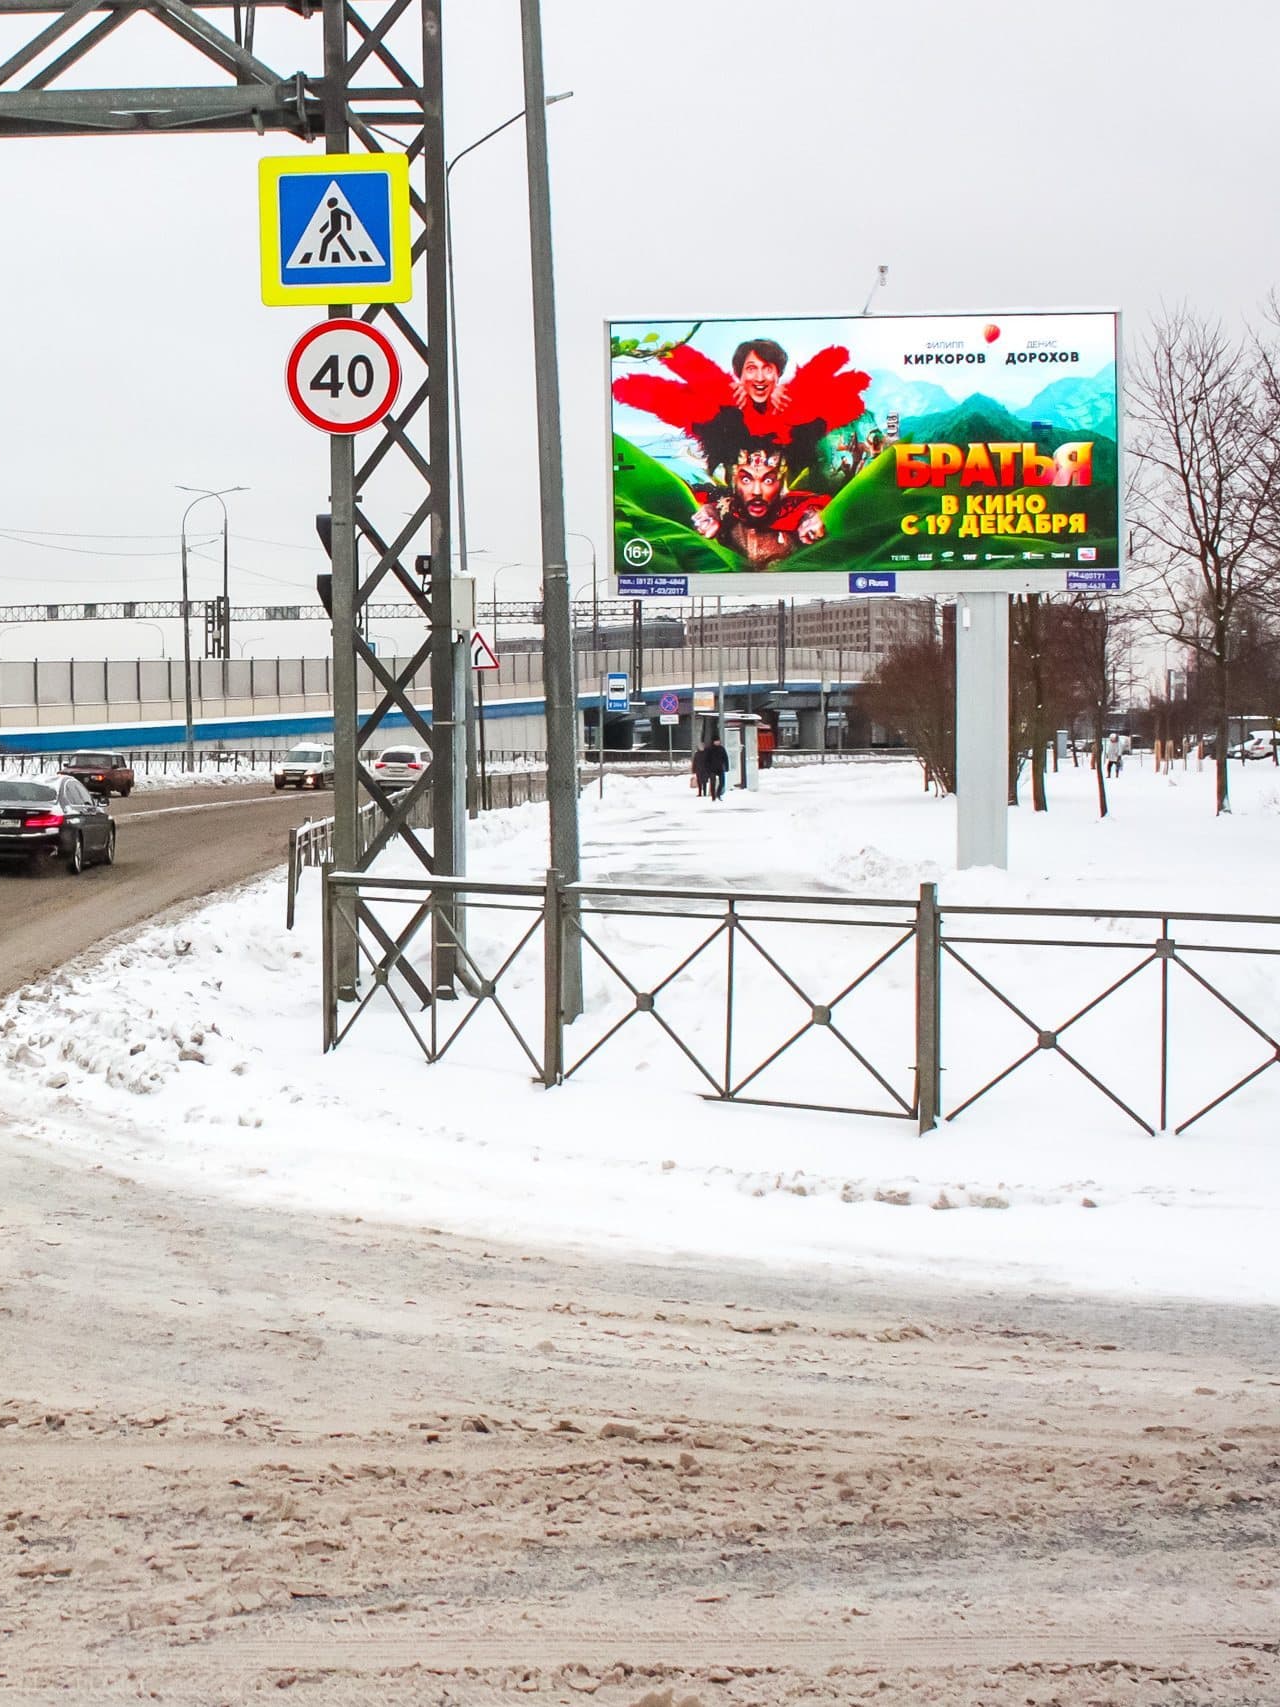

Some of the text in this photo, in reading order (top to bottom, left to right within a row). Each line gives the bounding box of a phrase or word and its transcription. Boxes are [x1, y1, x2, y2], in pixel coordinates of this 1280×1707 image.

[926, 341, 964, 349] ФИЛИПП
[1026, 340, 1057, 349] ДЕНИС
[904, 353, 986, 365] КИРКОРОВ
[1005, 351, 1080, 365] ДОРОХОВ
[309, 354, 374, 398] 40
[894, 441, 1094, 488] БРАТЬЯ
[941, 494, 1046, 515] В КИНО
[900, 513, 1088, 538] С 19 ДЕКАБРЯ
[627, 546, 649, 558] 16+
[868, 579, 889, 587] Russ
